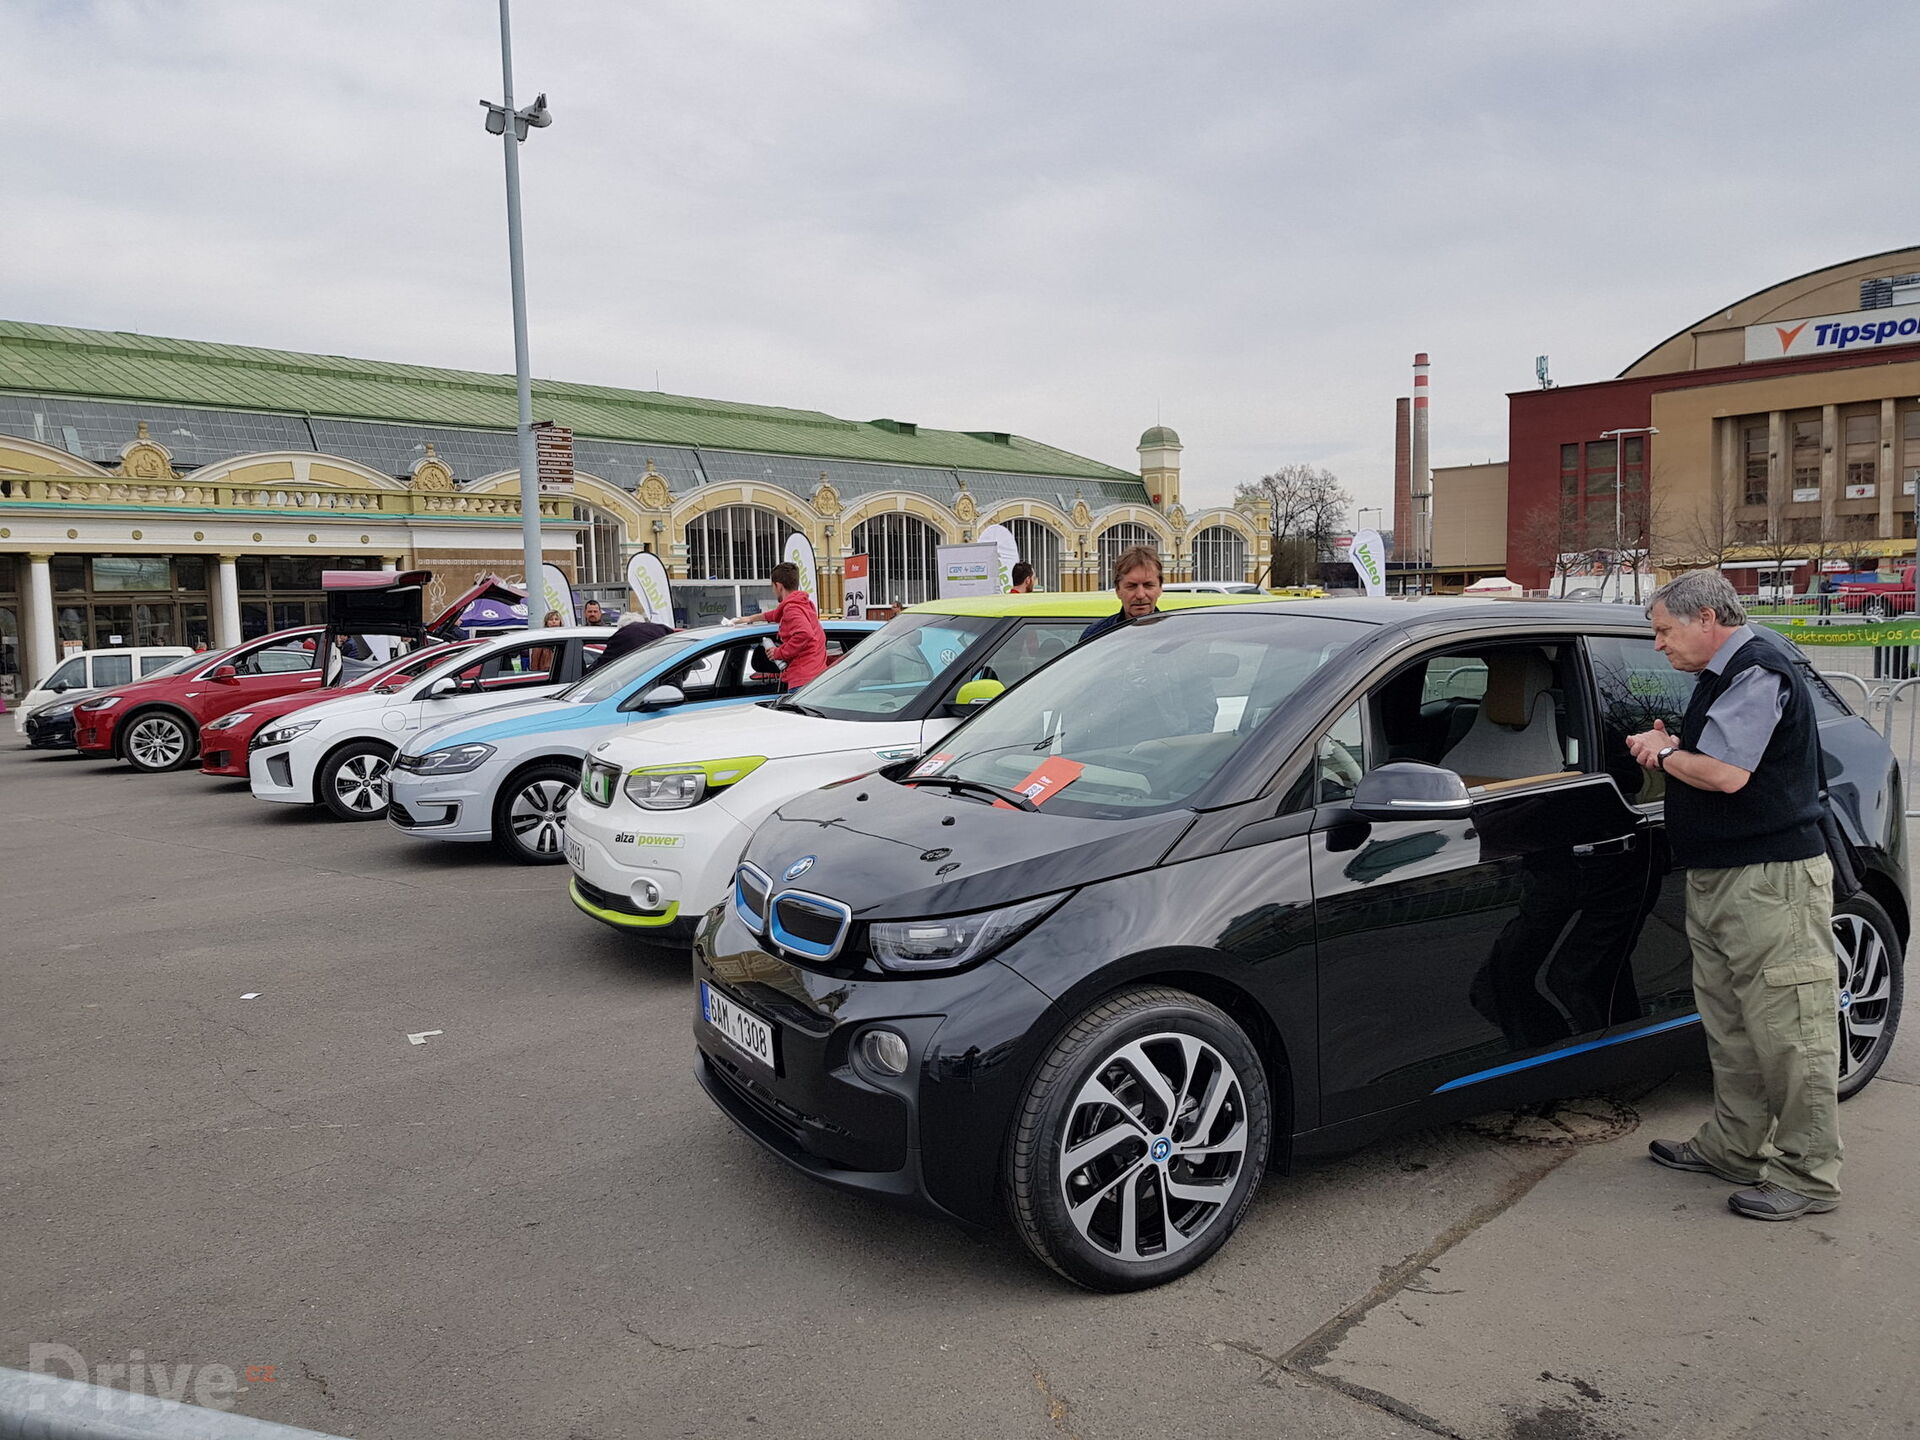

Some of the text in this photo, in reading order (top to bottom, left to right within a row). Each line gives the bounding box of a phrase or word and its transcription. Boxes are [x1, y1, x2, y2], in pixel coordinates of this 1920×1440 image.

[1814, 318, 1920, 348] Tipspo
[1359, 543, 1380, 585] Valeo
[615, 832, 680, 846] alza power
[737, 1012, 767, 1058] 1308
